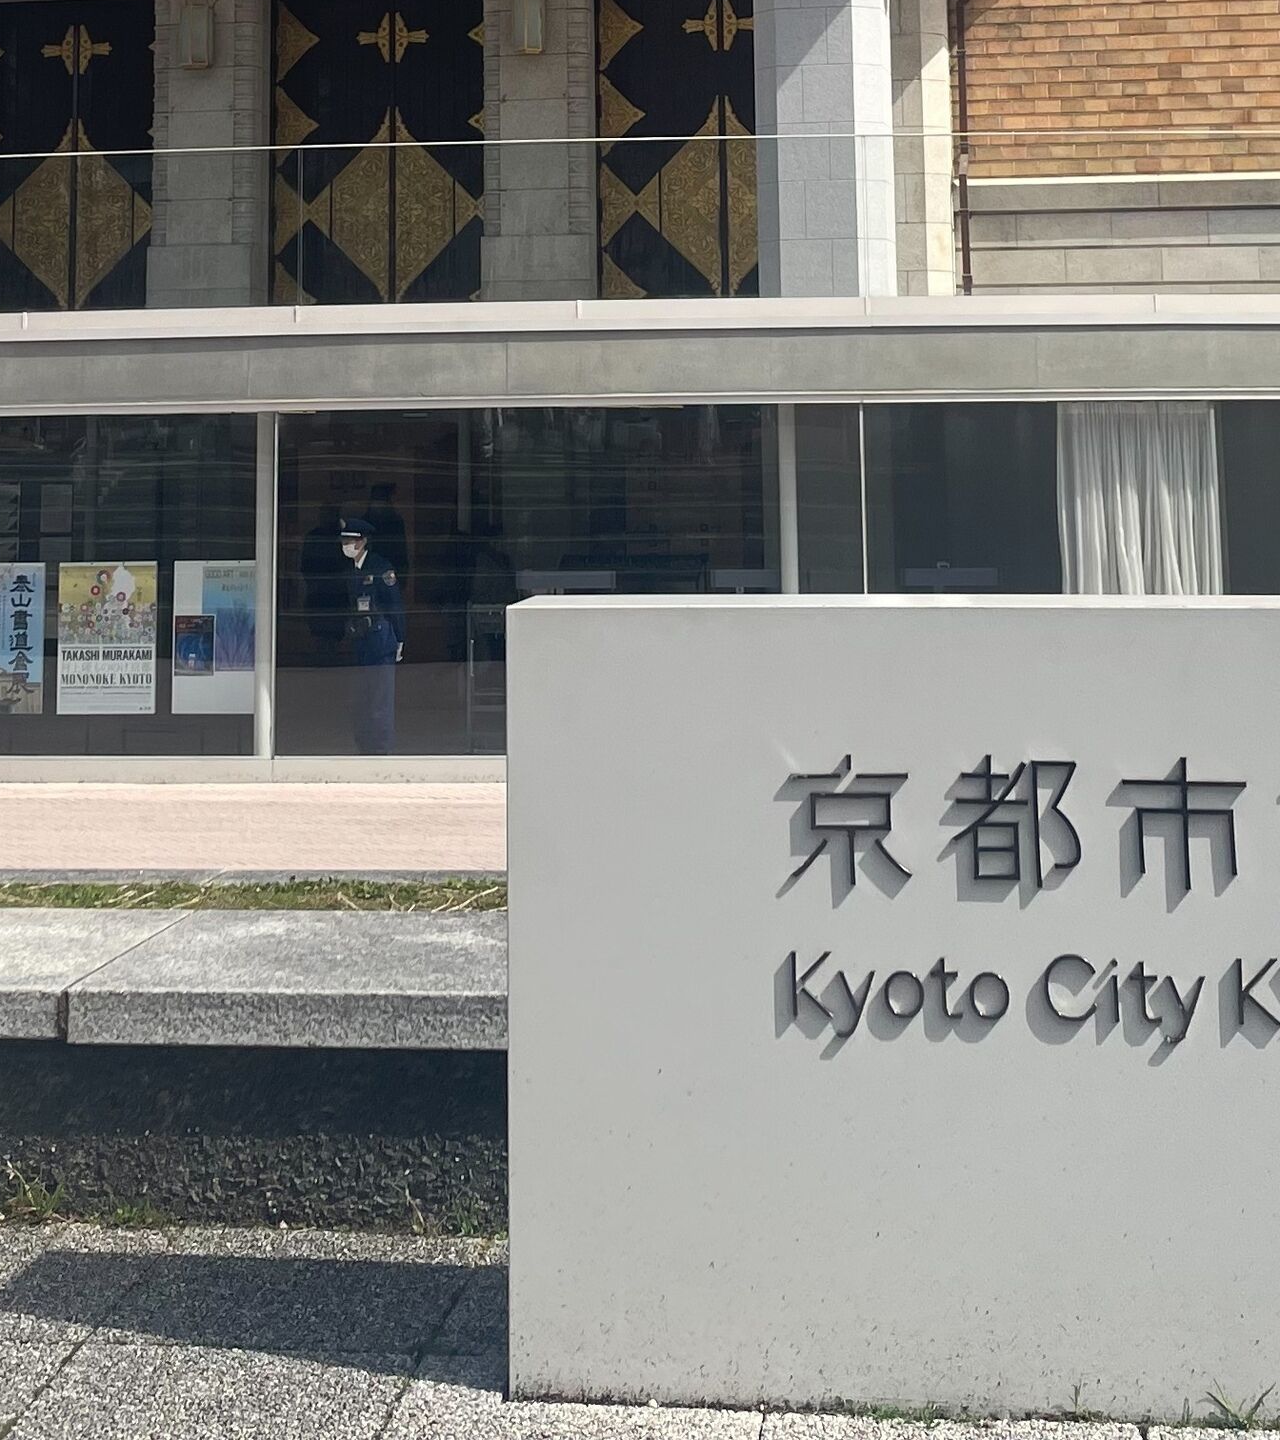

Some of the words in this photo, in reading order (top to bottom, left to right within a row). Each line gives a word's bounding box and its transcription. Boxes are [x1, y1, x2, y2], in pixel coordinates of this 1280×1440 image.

[61, 650, 100, 660] TAKASHI
[102, 650, 152, 660] MURAKAMI
[61, 673, 117, 685] MONONOKE
[119, 673, 152, 685] KYOTO
[789, 951, 1010, 1039] Kyoto
[1044, 954, 1206, 1043] City
